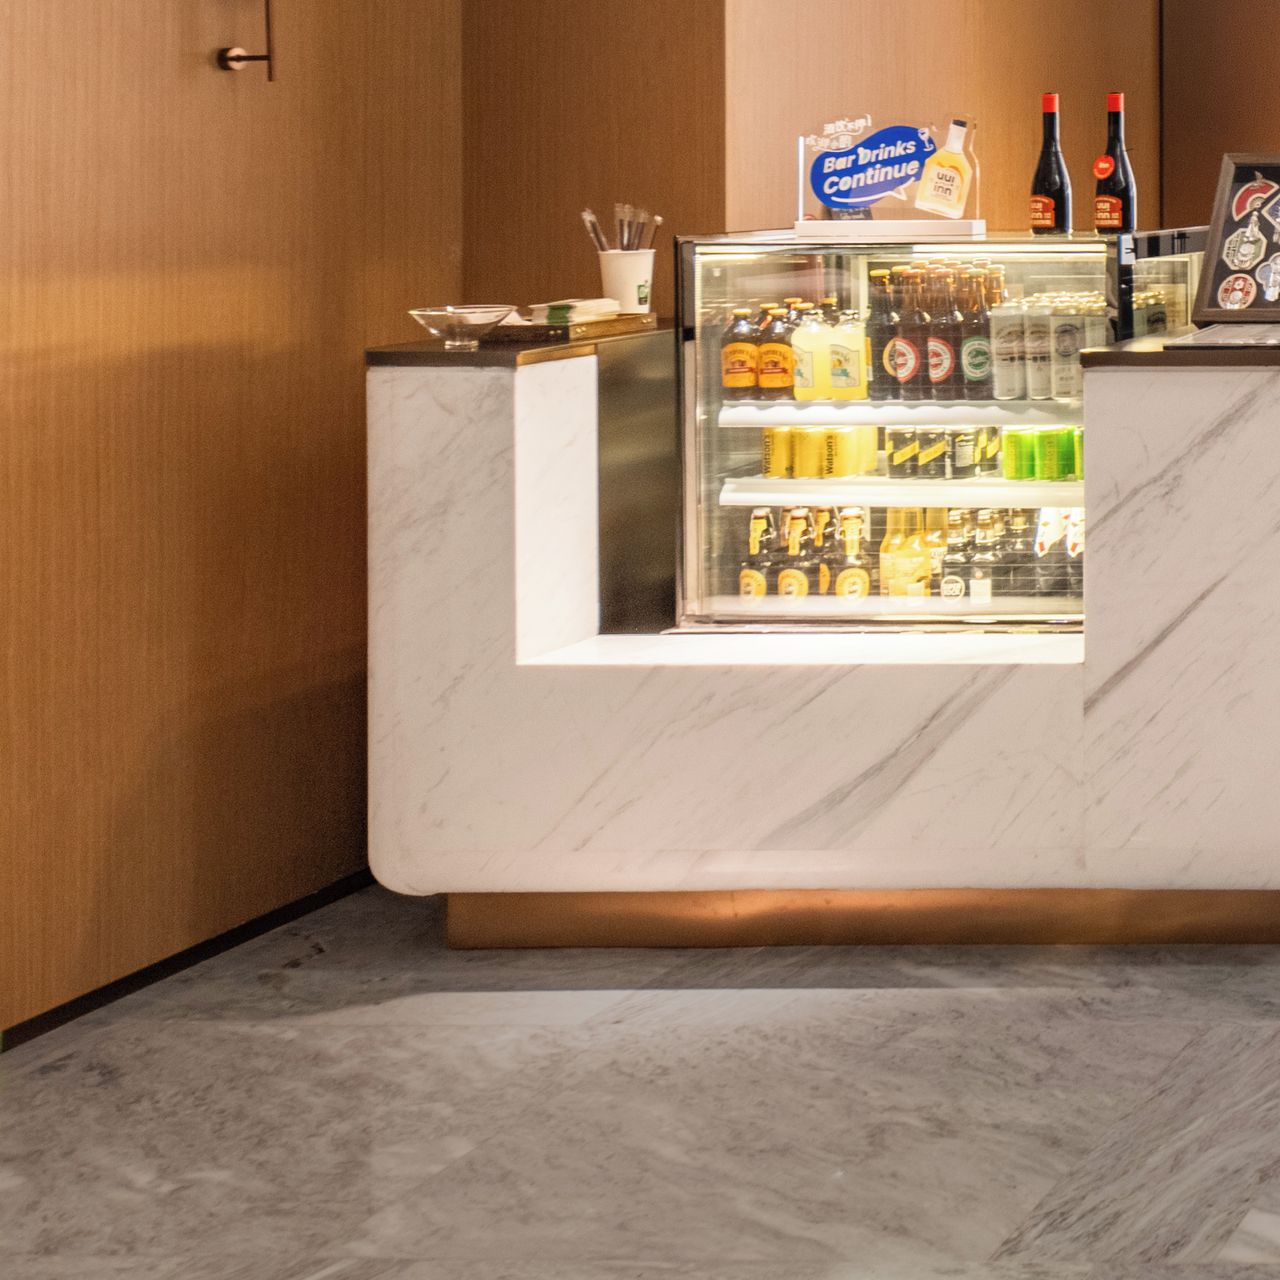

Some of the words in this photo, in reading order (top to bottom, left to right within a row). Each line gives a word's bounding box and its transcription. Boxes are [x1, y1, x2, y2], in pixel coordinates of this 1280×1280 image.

[823, 154, 856, 173] Bar
[857, 140, 917, 165] Drinks
[823, 160, 920, 194] Continue
[825, 433, 834, 475] Watson's
